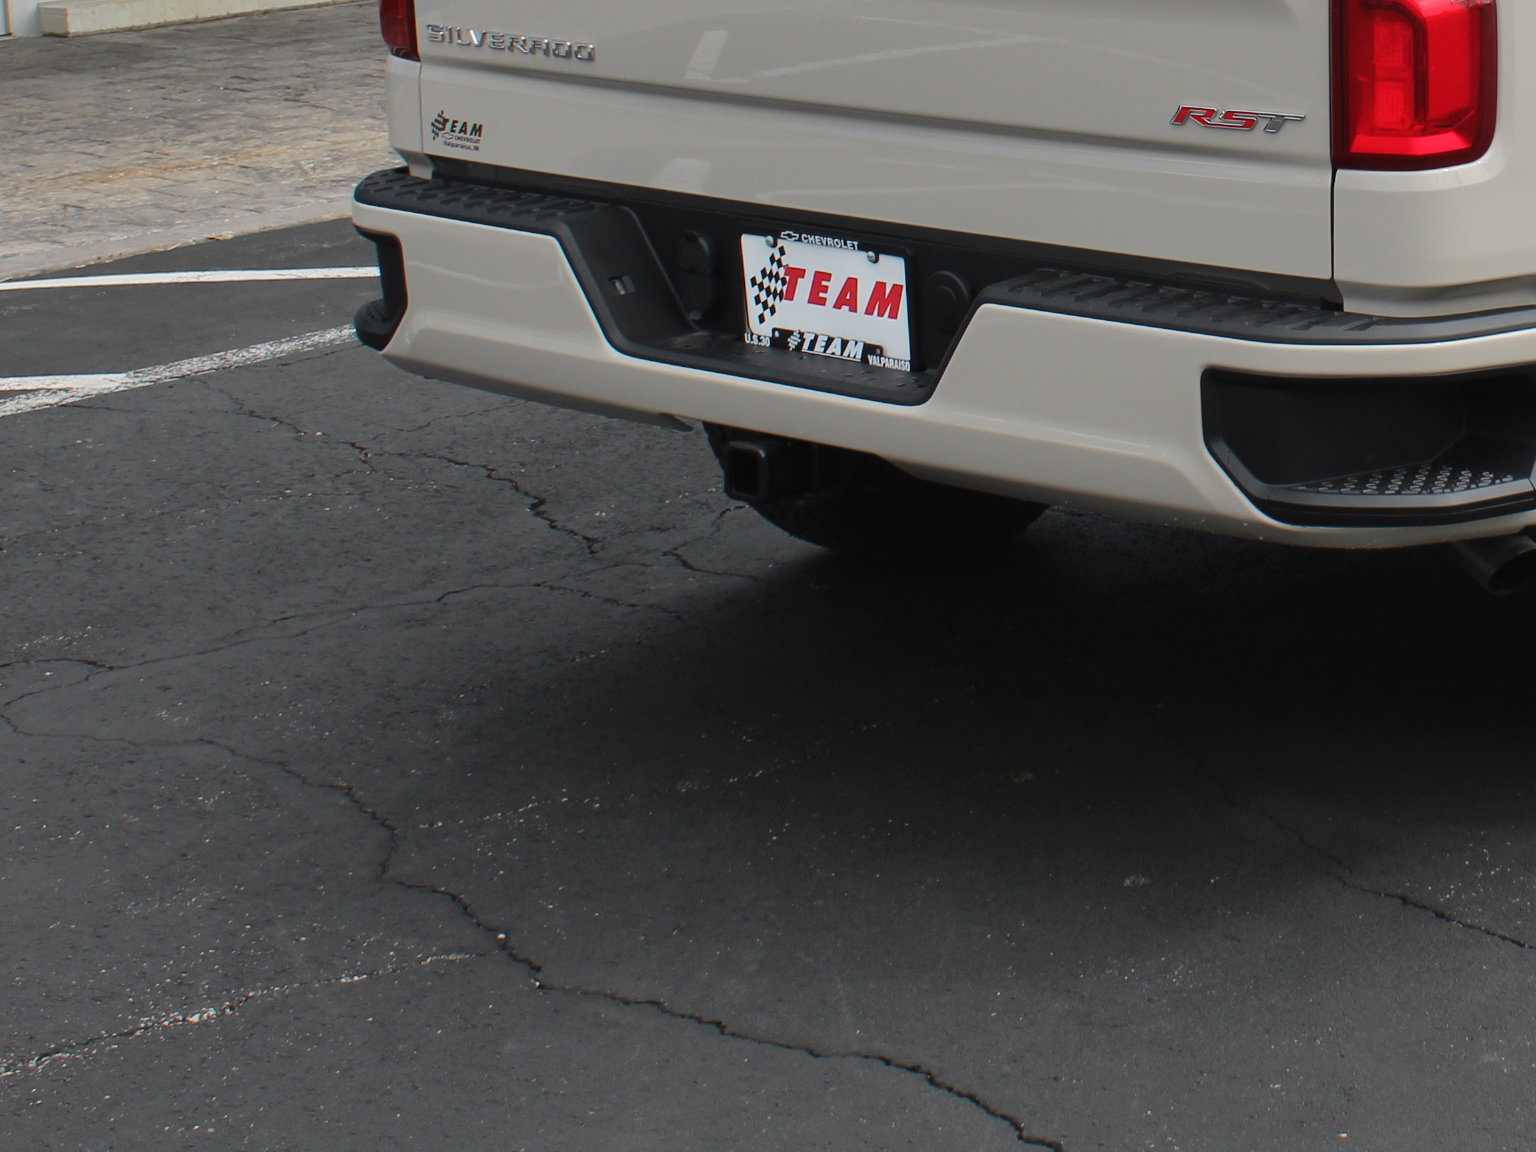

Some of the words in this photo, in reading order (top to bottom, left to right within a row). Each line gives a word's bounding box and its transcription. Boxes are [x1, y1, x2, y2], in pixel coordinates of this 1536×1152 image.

[426, 24, 596, 62] SILVERADO
[442, 117, 483, 137] TEAM
[1170, 105, 1306, 133] RST
[800, 233, 859, 250] CHEVROLET
[783, 265, 904, 320] TEAM
[801, 332, 865, 360] TEAM
[867, 354, 911, 372] VALPARAISO
